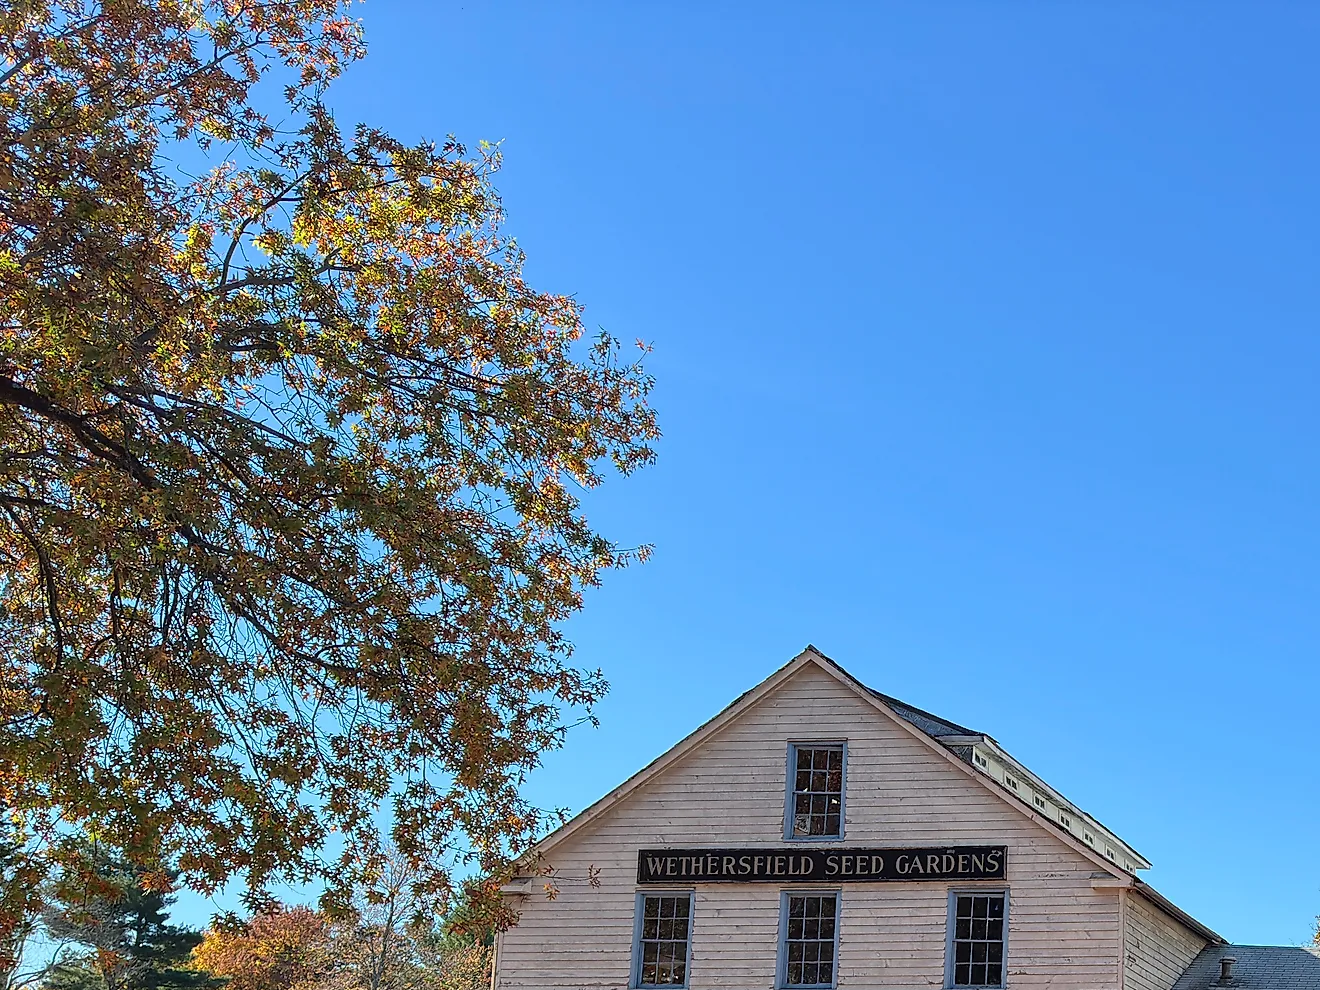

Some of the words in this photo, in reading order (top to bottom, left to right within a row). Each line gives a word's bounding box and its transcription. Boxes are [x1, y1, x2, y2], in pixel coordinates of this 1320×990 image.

[646, 855, 814, 876] WETHERSFIELD
[825, 855, 884, 875] SEED
[895, 853, 1000, 874] GARDENS
